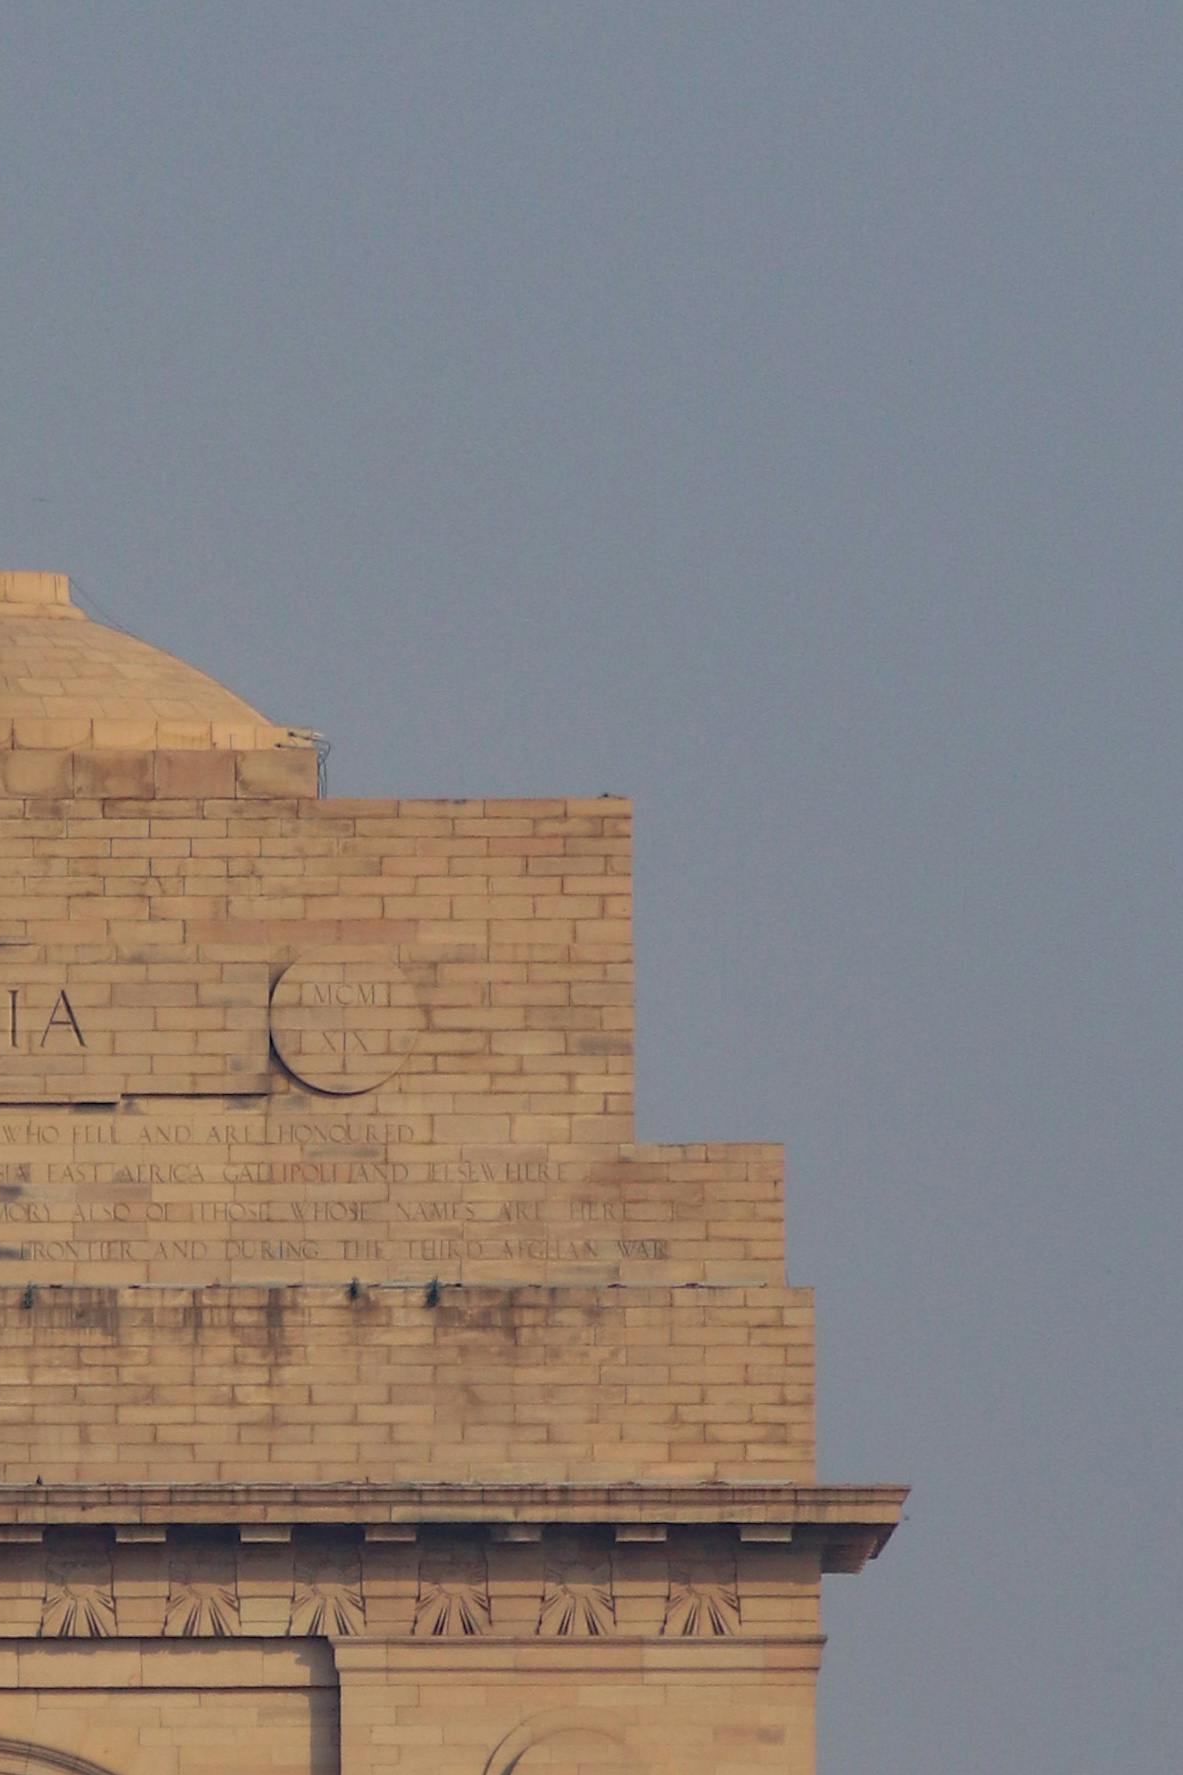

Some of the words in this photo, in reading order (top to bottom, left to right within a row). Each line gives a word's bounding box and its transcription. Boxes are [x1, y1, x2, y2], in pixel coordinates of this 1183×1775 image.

[314, 984, 376, 1005] MCM
[320, 1032, 369, 1052] XIX
[2, 1124, 60, 1143] WHO
[73, 1124, 120, 1143] FELL
[139, 1124, 192, 1143] AND
[206, 1124, 256, 1143] ARE
[278, 1124, 414, 1142] HONOURED
[47, 1164, 101, 1182] EAST
[121, 1164, 205, 1182] AFRICA
[357, 1163, 410, 1181] AND
